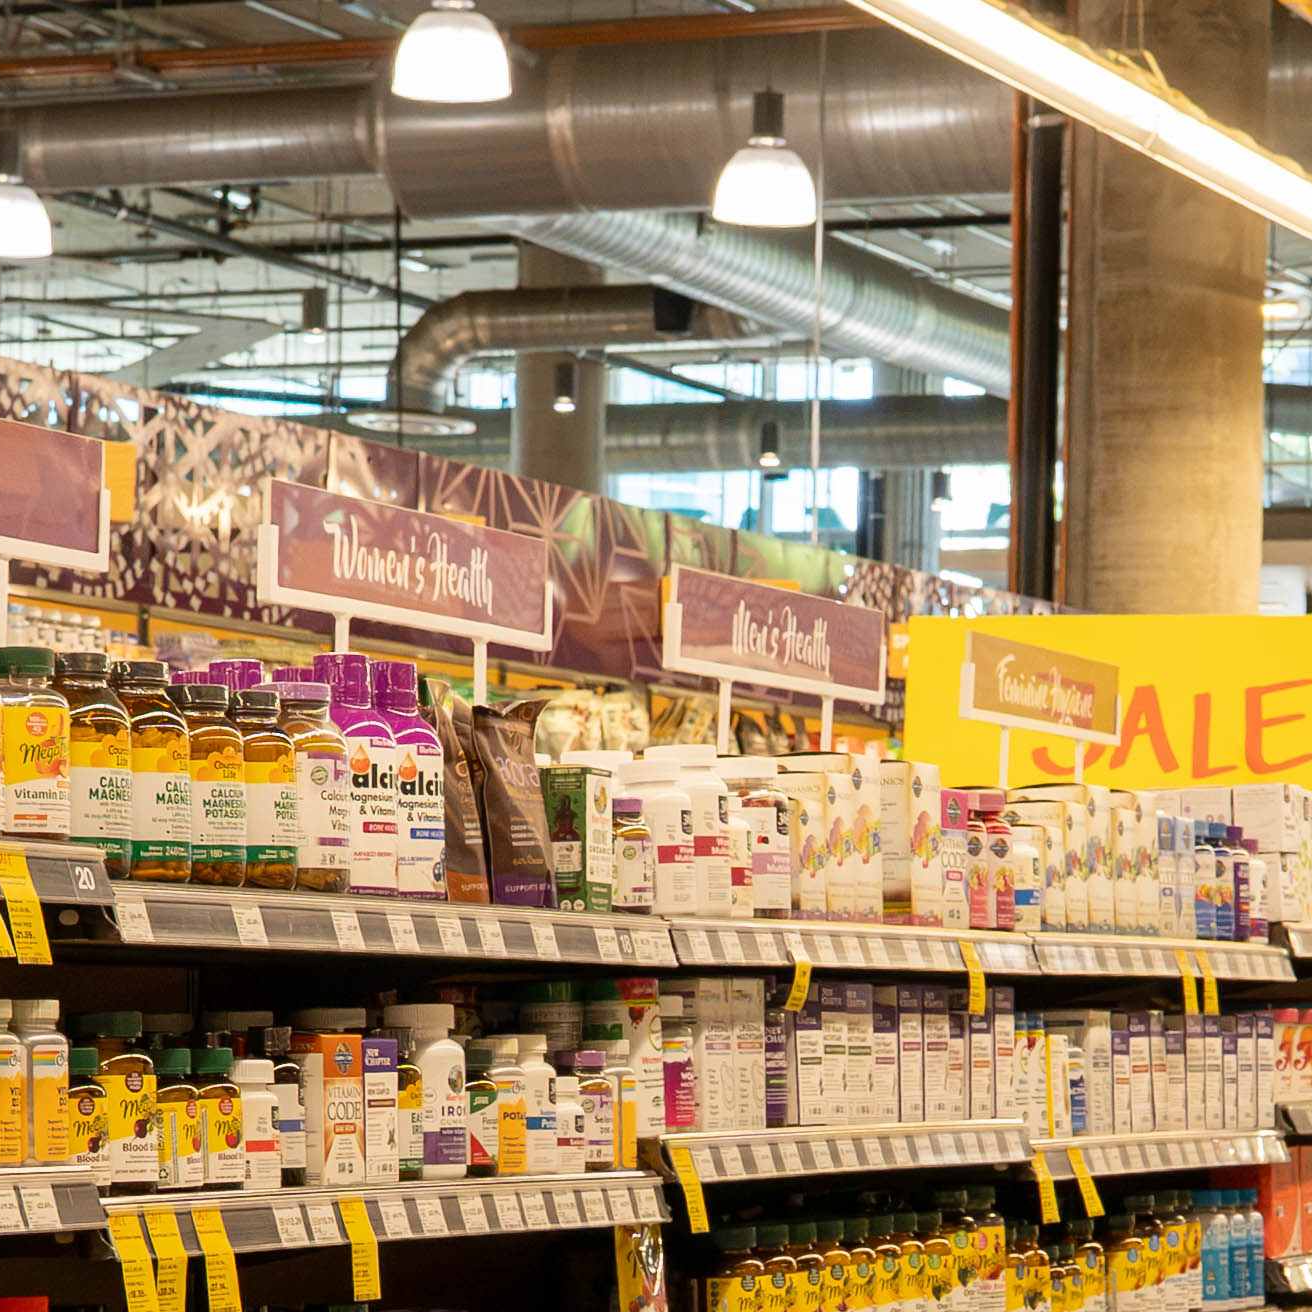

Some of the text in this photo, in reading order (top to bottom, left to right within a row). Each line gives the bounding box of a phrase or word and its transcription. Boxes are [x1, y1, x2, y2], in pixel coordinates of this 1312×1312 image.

[324, 513, 494, 617] Women's Health
[732, 599, 832, 676] Men's Health
[14, 788, 57, 801] Vitamin
[74, 866, 96, 891] 20
[327, 1101, 362, 1121] CODE
